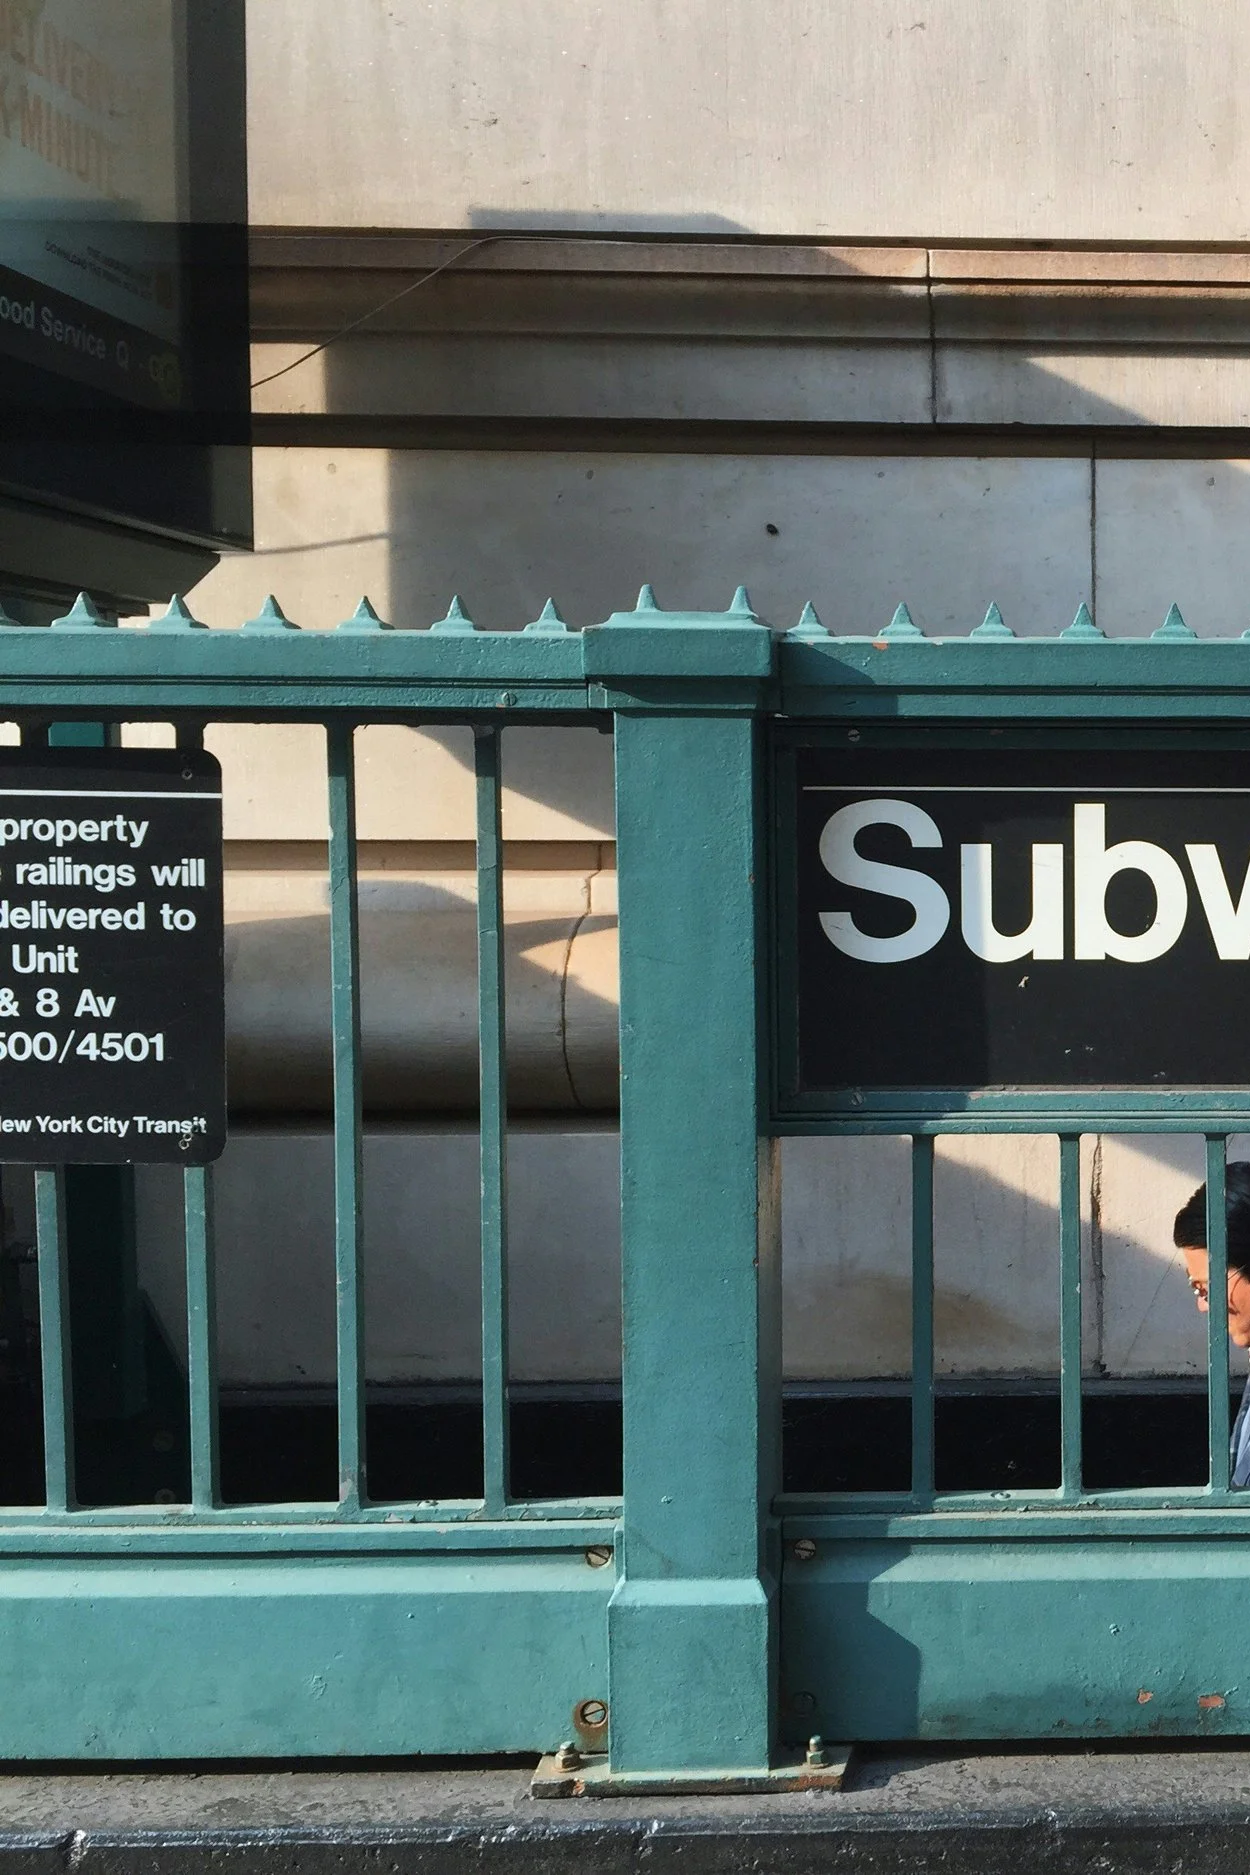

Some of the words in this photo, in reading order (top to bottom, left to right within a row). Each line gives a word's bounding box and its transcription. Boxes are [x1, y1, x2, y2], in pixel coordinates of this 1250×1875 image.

[40, 305, 107, 360] Service
[115, 340, 131, 372] Q
[0, 815, 149, 848] property
[15, 857, 136, 892] railings
[151, 858, 206, 887] will
[160, 904, 197, 931] to
[12, 944, 80, 974] Unit
[0, 988, 20, 1017] &
[36, 988, 61, 1017] 8
[74, 989, 117, 1018] Av
[0, 1116, 32, 1133] ew
[36, 1116, 84, 1133] York
[87, 1116, 130, 1138] City
[133, 1116, 207, 1134] Transit
